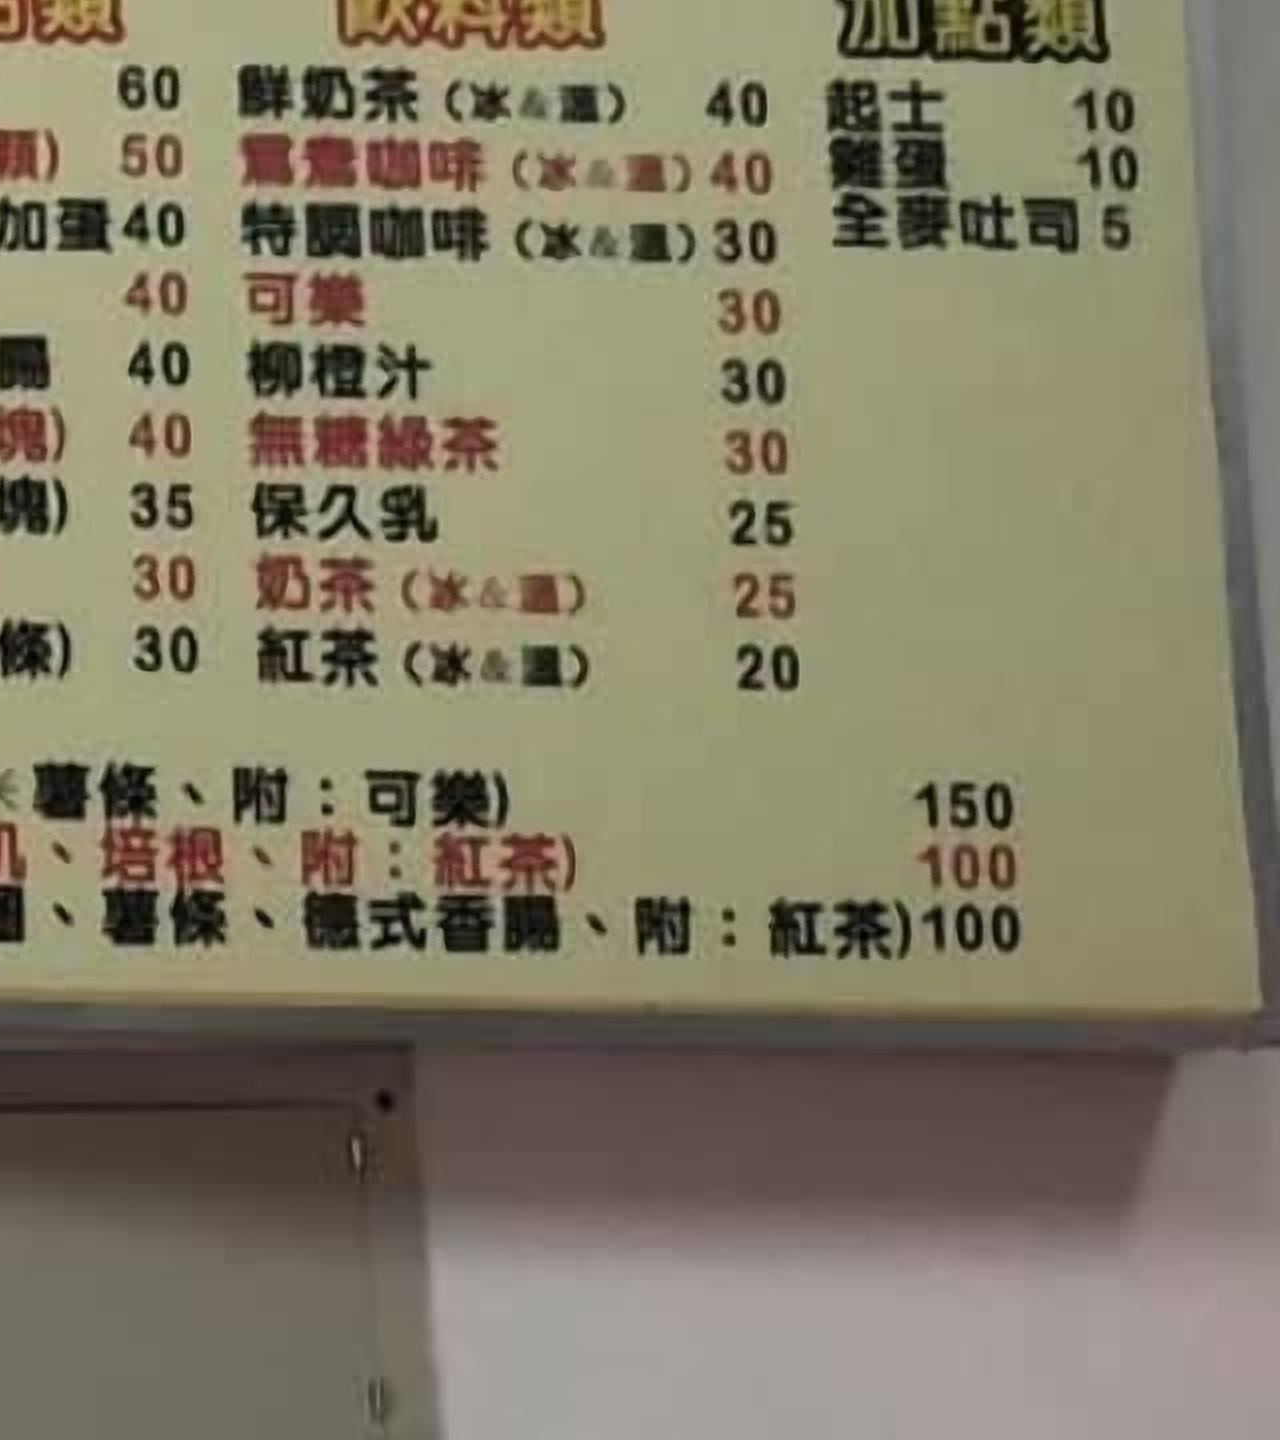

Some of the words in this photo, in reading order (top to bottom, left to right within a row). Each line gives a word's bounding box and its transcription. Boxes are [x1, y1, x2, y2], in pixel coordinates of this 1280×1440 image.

[118, 65, 180, 110] 60
[706, 82, 767, 127] 40
[827, 79, 944, 136] 起士
[1074, 89, 1134, 133] 10
[121, 134, 182, 178] 50
[711, 152, 772, 195] 40
[828, 138, 949, 192] 雞蛋
[1078, 145, 1138, 191] 10
[122, 202, 185, 247] 40
[714, 219, 777, 264] 30
[832, 191, 1079, 254] 全麥吐司
[1103, 205, 1131, 250] 5
[125, 272, 187, 315] 40
[244, 272, 365, 327] 可樂
[719, 289, 780, 335] 30
[128, 341, 190, 387] 40
[246, 340, 432, 401] 柳橙汁
[721, 358, 786, 405] 30
[129, 413, 191, 458] 40
[727, 430, 787, 474] 30
[131, 482, 194, 530] 35
[251, 482, 438, 543] 保久乳
[729, 500, 793, 547] 25
[134, 554, 195, 601] 30
[734, 573, 795, 619] 25
[134, 626, 198, 674] 30
[737, 644, 799, 691] 20
[915, 782, 1013, 829] 150
[919, 845, 1018, 890] 100
[922, 904, 1022, 954] 100
